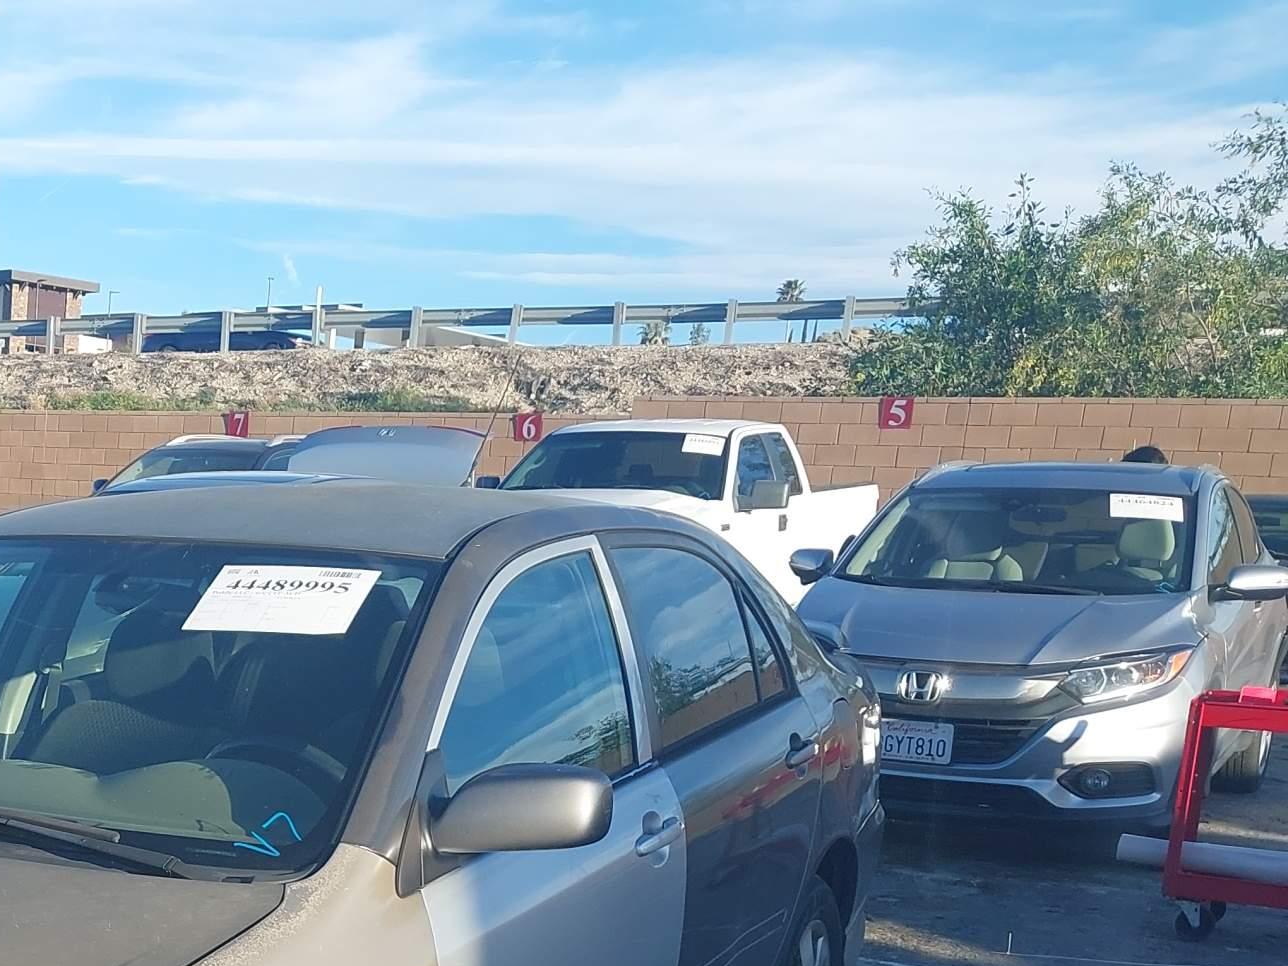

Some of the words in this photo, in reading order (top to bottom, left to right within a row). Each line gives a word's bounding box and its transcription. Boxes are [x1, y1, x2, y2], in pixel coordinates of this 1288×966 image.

[887, 399, 908, 426] 5
[233, 413, 245, 436] 7
[522, 415, 536, 440] 6
[226, 578, 353, 594] 44489995
[881, 734, 946, 757] GYT810
